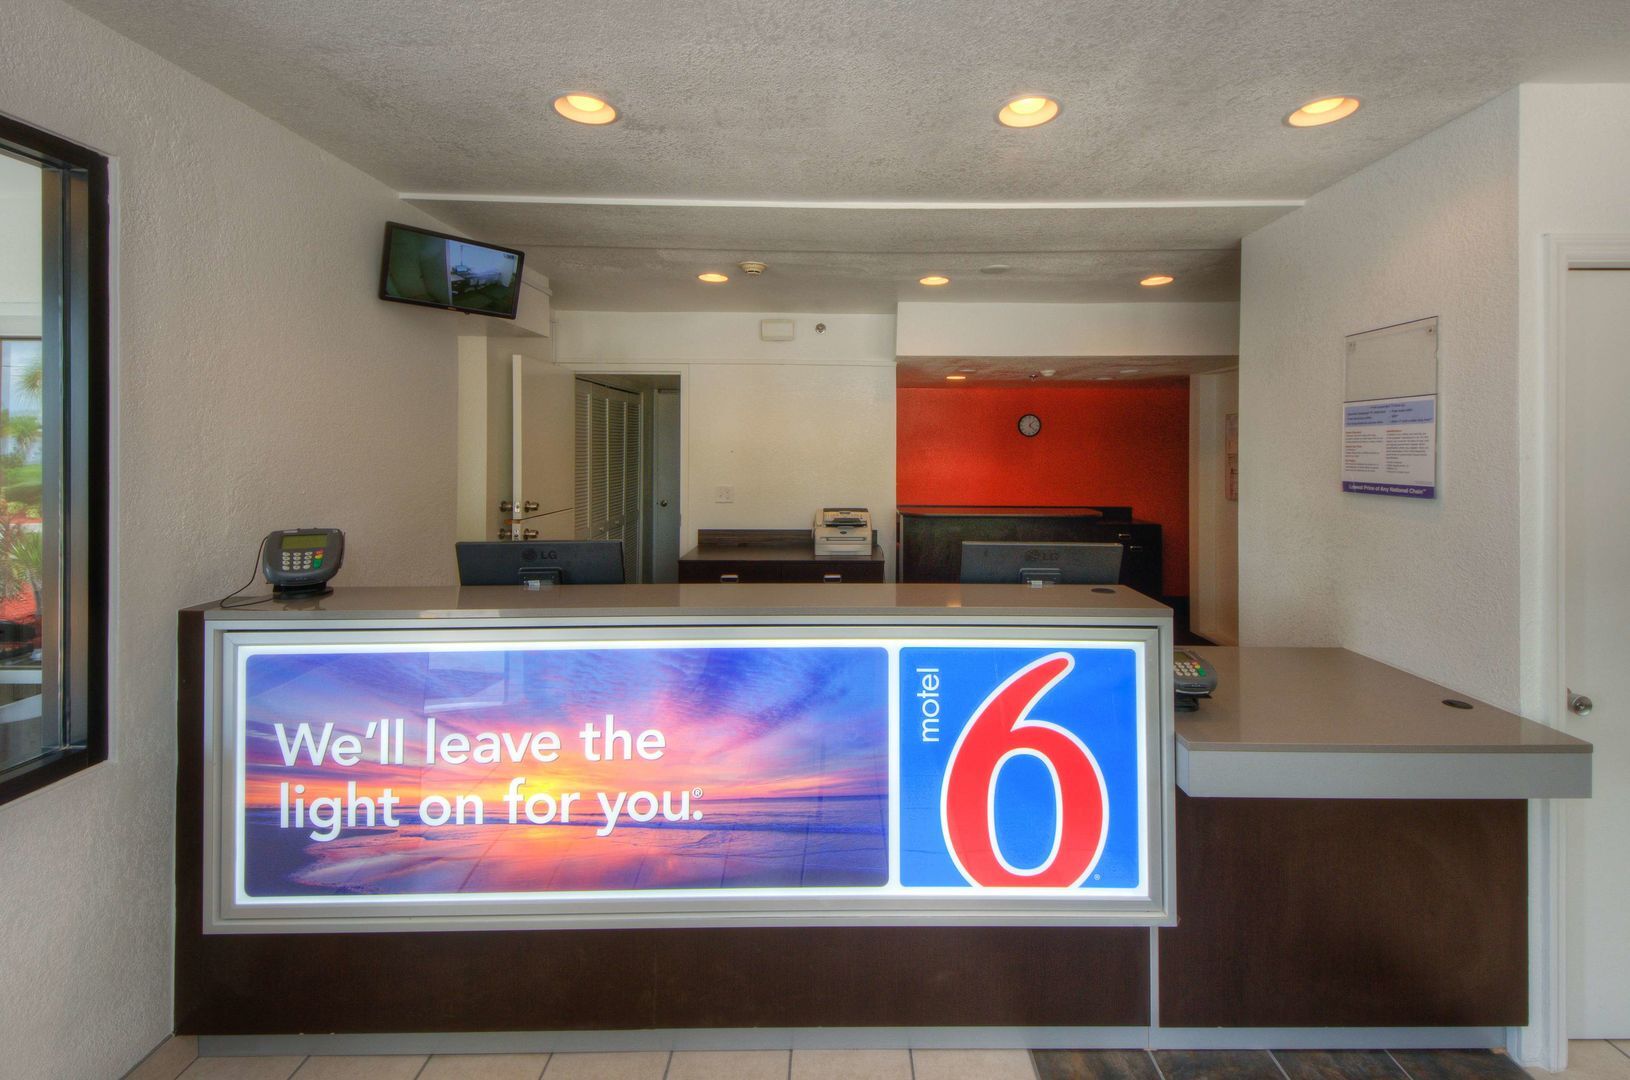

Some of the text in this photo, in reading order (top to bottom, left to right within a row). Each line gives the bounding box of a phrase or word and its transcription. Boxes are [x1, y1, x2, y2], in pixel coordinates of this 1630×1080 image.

[540, 551, 558, 560] LG
[1043, 552, 1059, 561] LG
[916, 668, 940, 742] motel
[426, 717, 562, 765] leave
[578, 714, 667, 762] the
[940, 651, 1110, 888] 6
[280, 781, 401, 842] light
[419, 793, 484, 826] on
[503, 776, 581, 825] for
